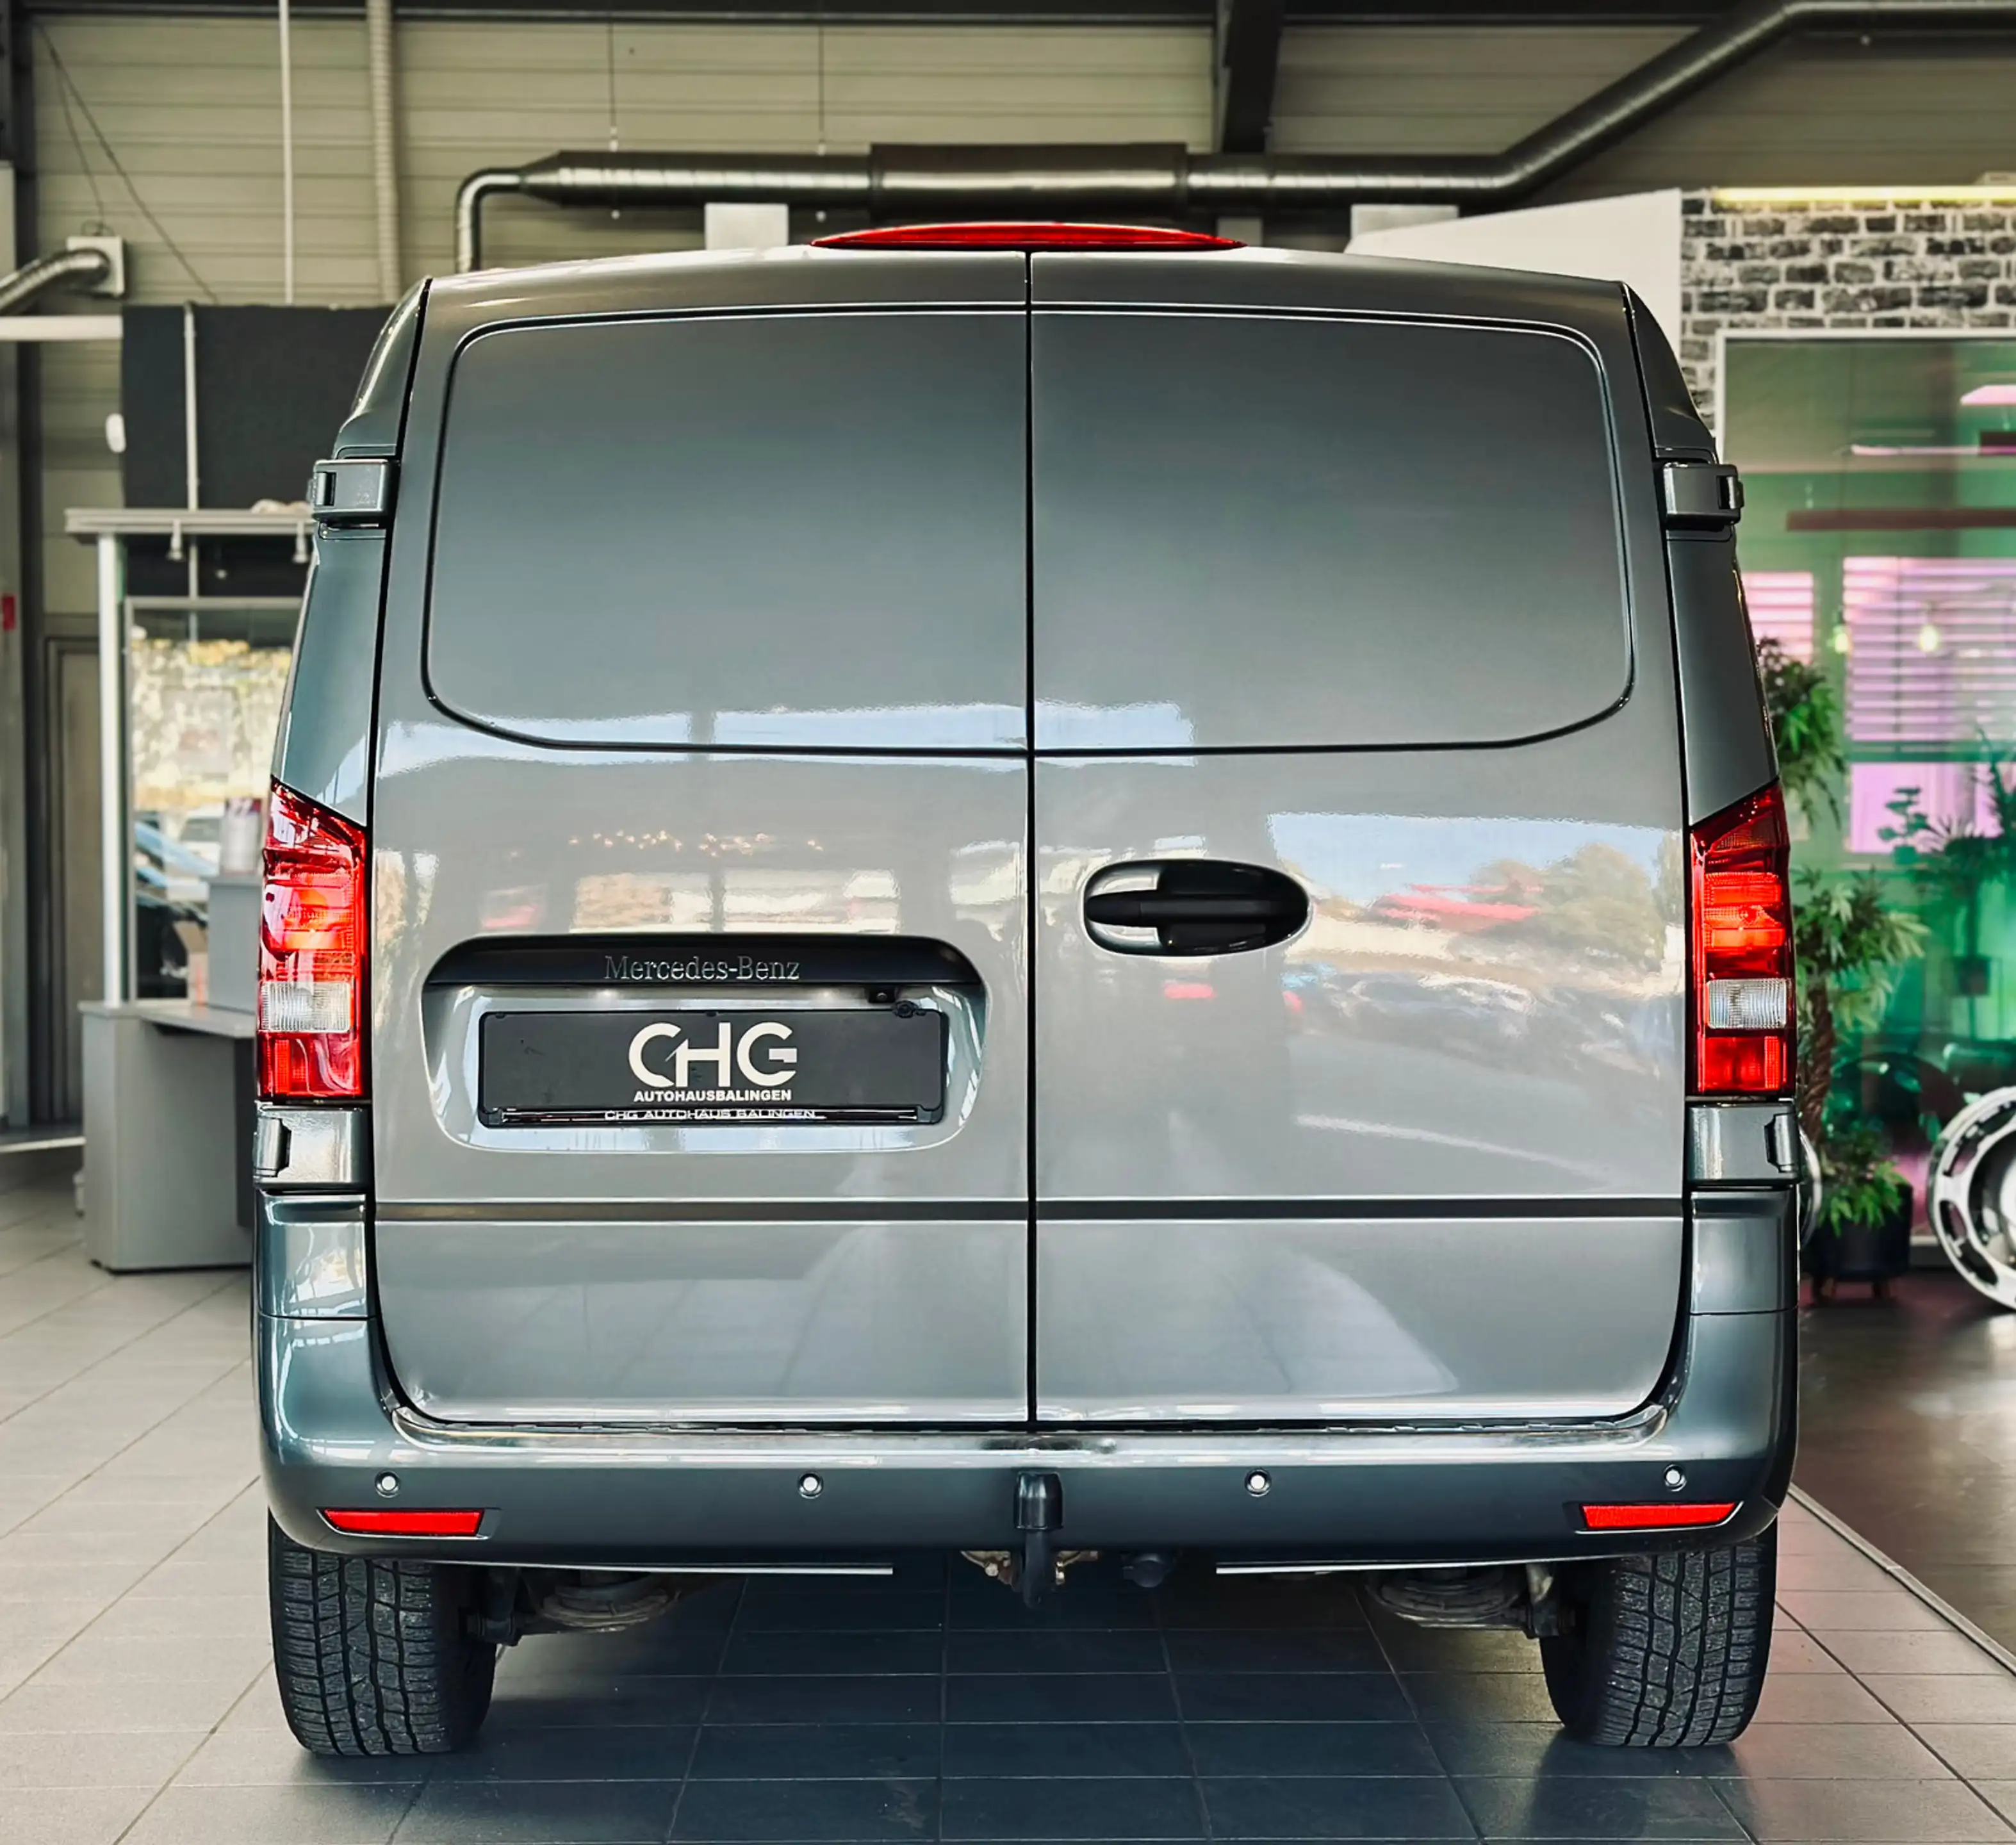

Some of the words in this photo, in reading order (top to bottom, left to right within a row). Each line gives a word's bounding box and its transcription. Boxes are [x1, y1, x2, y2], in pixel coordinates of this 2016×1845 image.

[603, 955, 800, 980] Mercedes-Benz
[628, 1022, 798, 1088] CHG
[633, 1090, 792, 1102] AUTOHAUSBALINGEN
[604, 1110, 638, 1120] CHG
[646, 1110, 731, 1120] AUTOHAUS
[737, 1109, 816, 1119] BALINGEN
